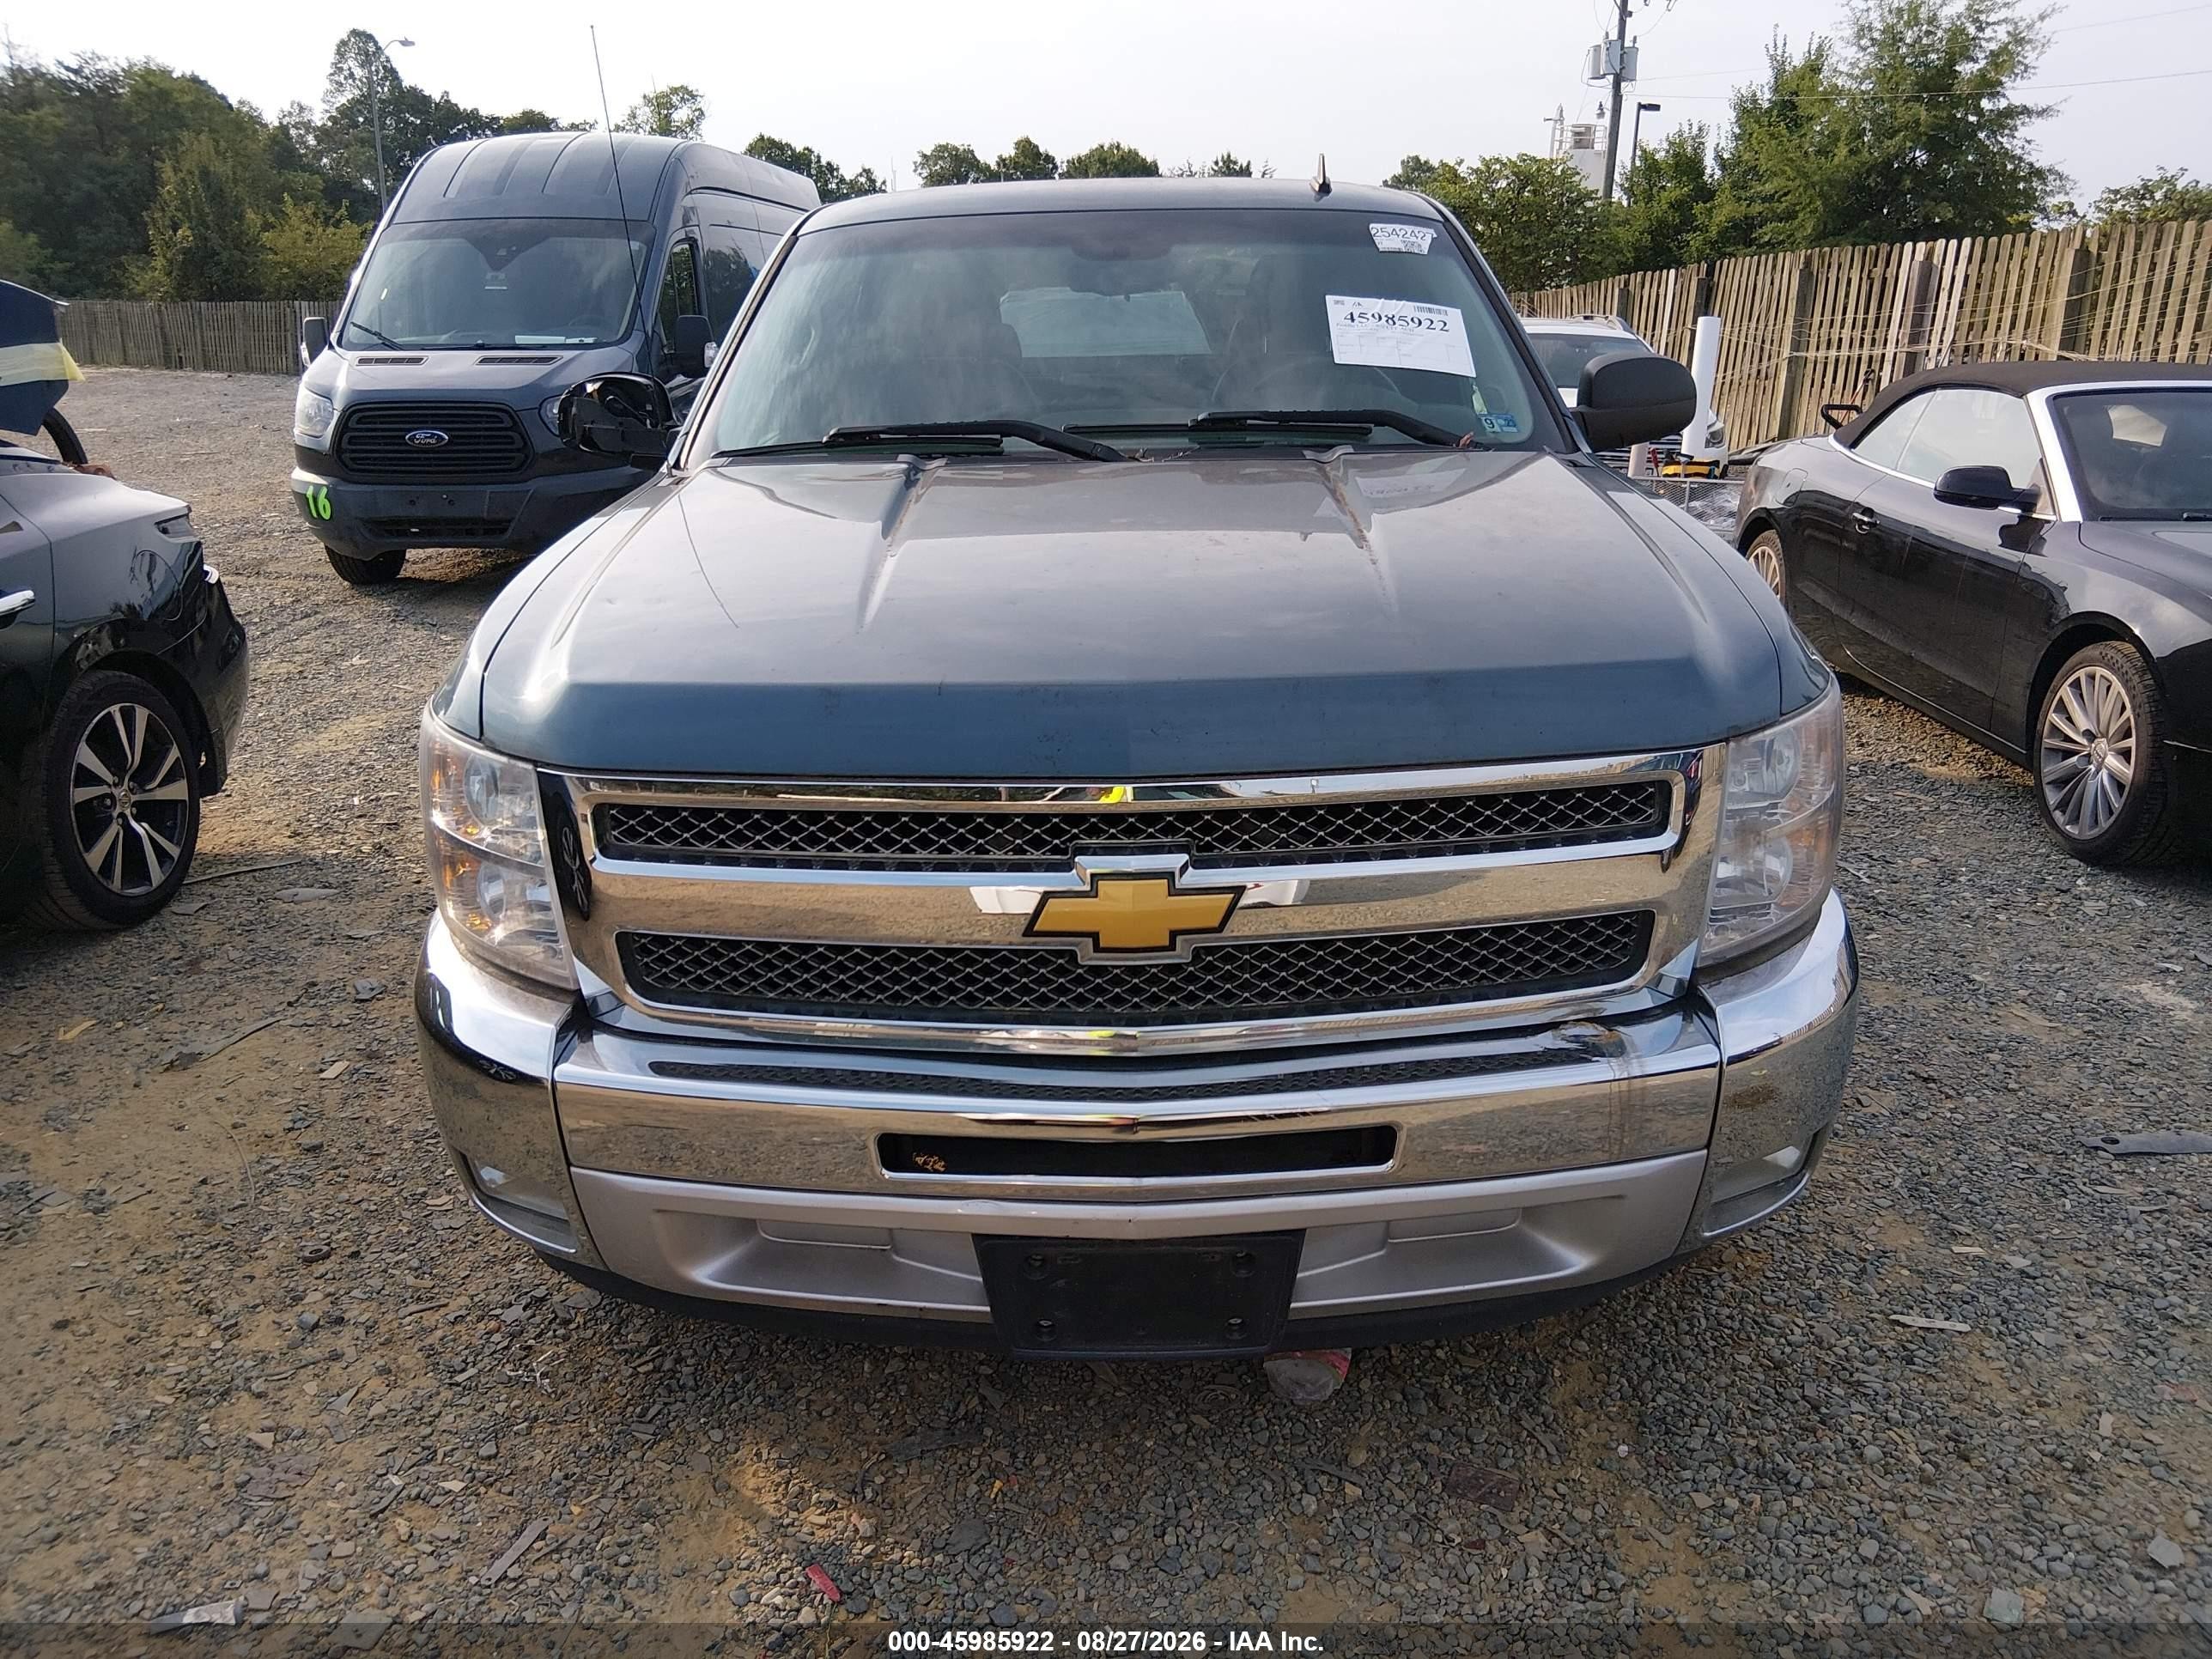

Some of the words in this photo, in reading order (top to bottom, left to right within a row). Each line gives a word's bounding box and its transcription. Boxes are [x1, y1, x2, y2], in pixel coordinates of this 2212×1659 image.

[1344, 311, 1449, 333] 45985922
[1484, 417, 1495, 428] 9
[414, 433, 438, 444] Ford
[306, 485, 331, 520] 16
